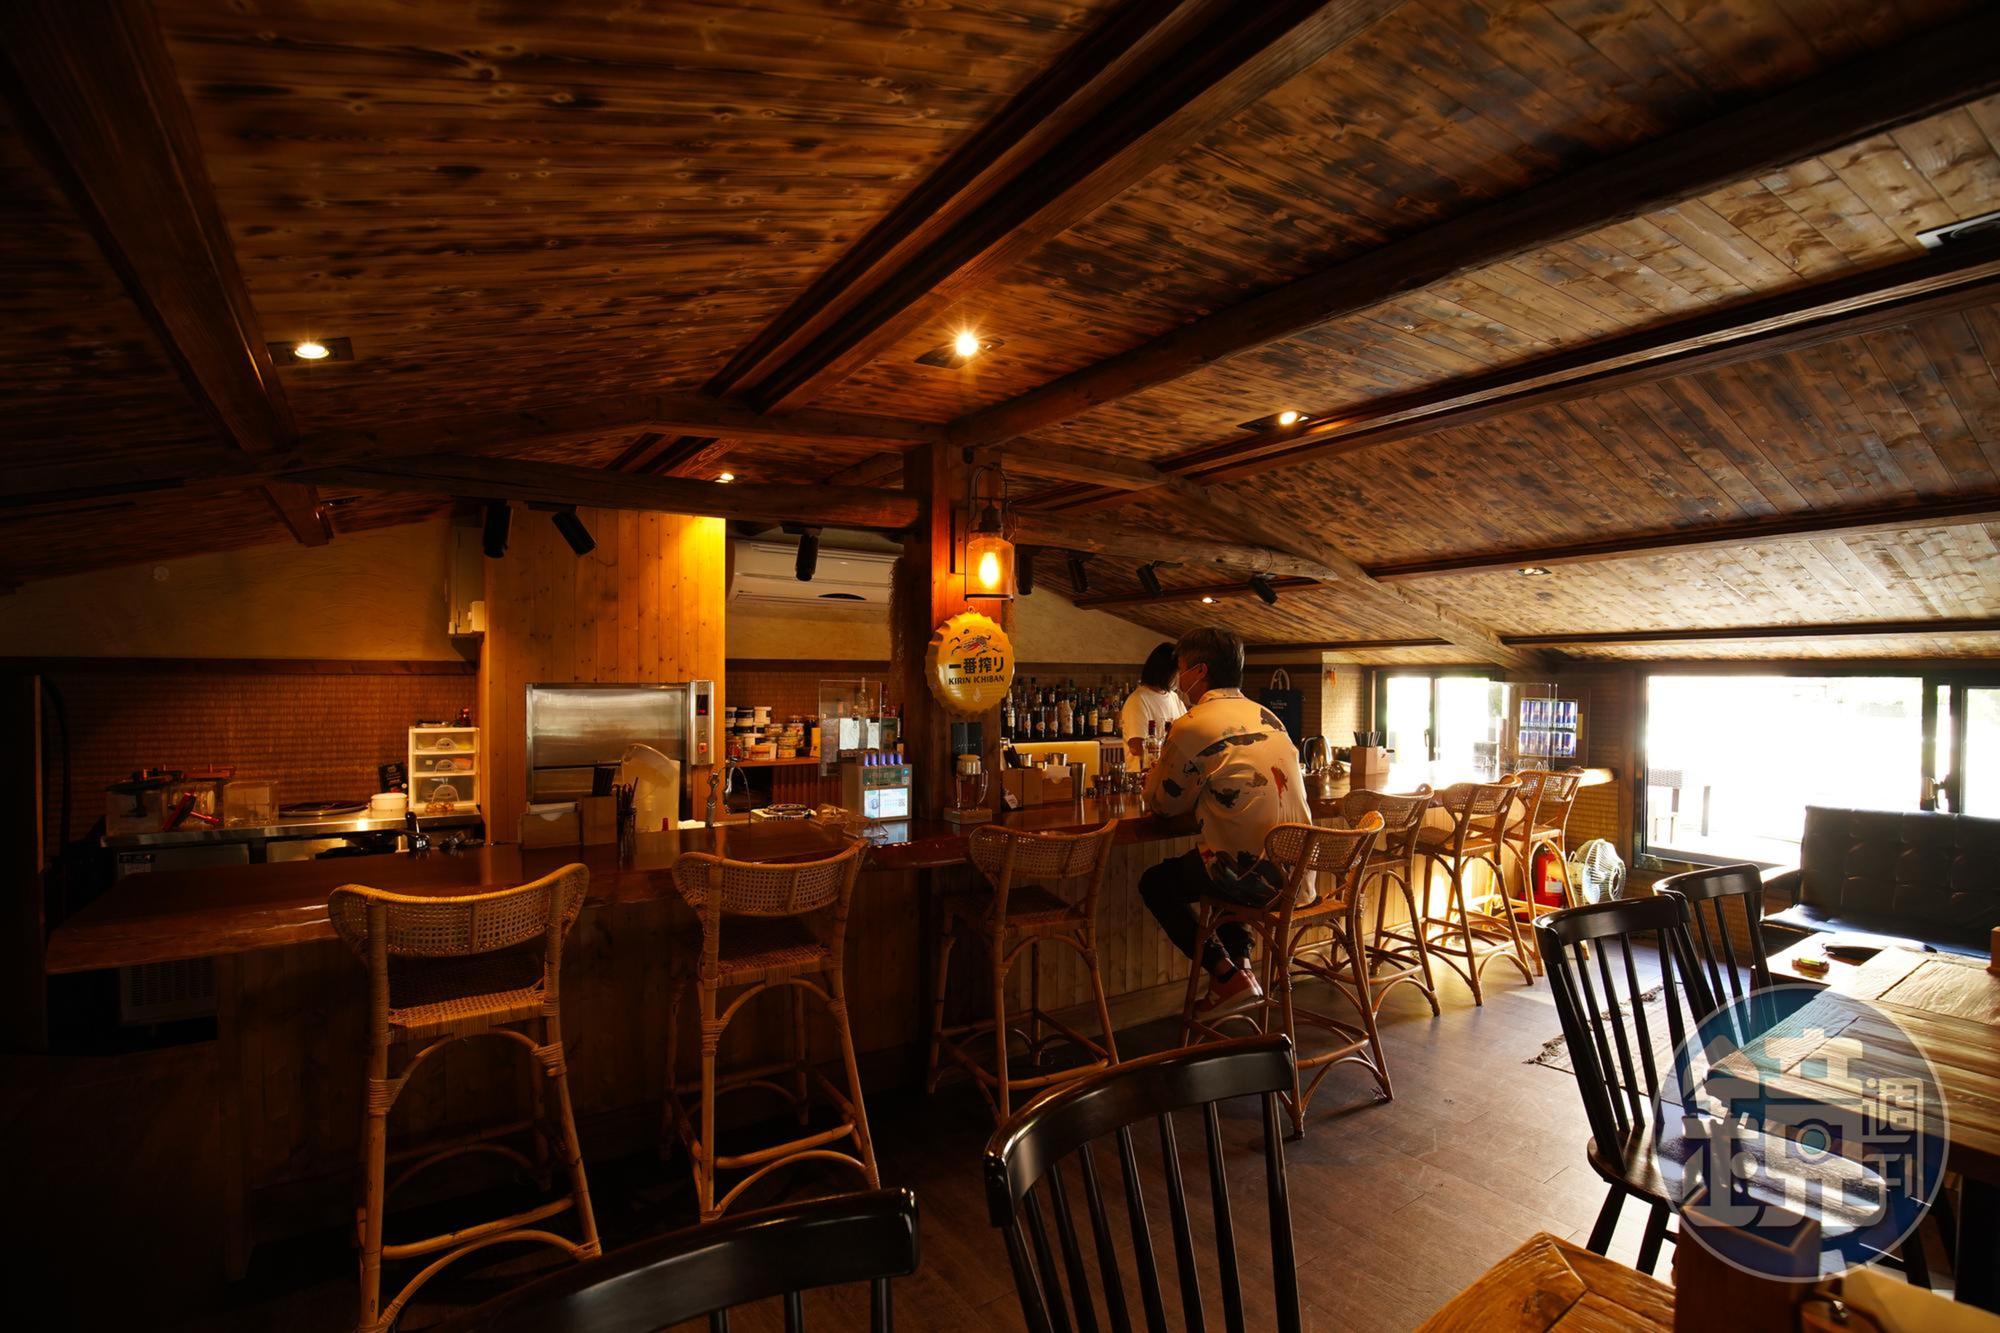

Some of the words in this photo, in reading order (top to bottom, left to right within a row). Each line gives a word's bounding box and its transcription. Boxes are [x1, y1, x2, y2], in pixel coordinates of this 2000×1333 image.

[948, 656, 1004, 674] 一番搾り
[948, 677, 970, 685] KIRIN
[973, 675, 1005, 684] ICHIBAN
